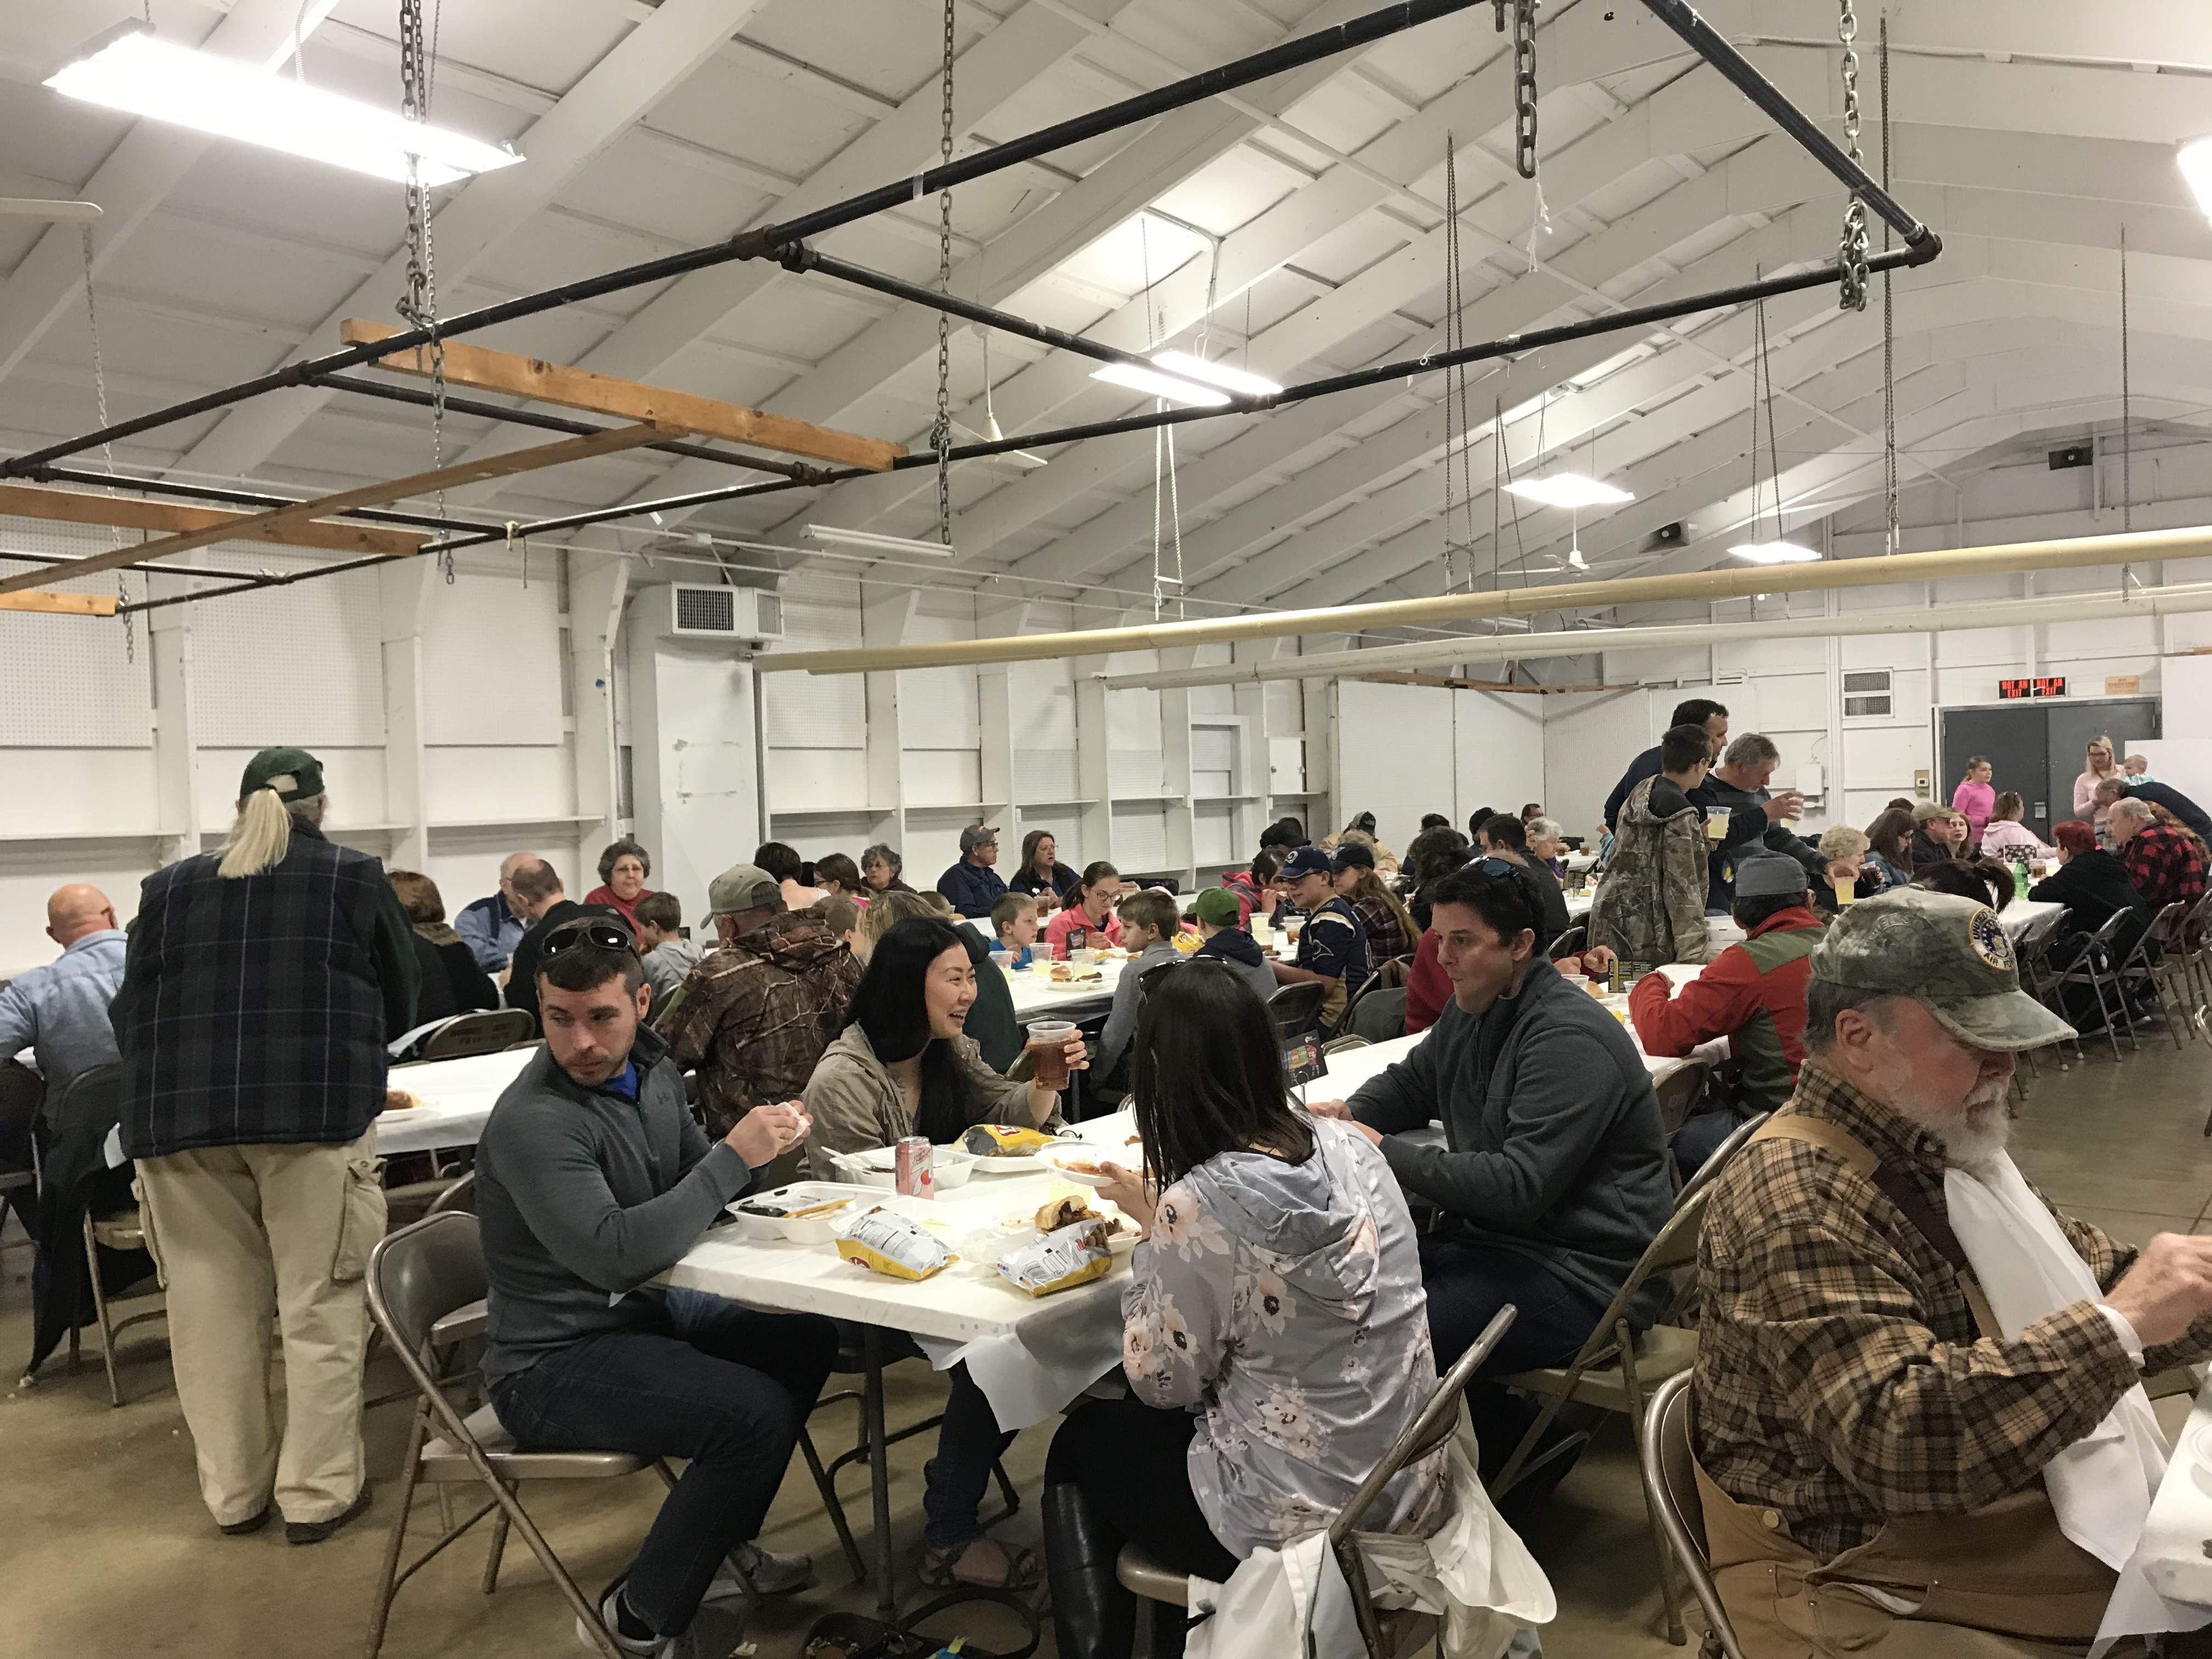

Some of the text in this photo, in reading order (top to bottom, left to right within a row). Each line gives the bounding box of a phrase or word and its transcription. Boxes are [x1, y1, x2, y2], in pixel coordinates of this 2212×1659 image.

[2002, 680, 2028, 690] NOT AN
[2036, 678, 2063, 687] NOT AN
[2007, 689, 2022, 698] EXIT
[2041, 686, 2056, 696] EXIT
[1983, 952, 1999, 966] AIR
